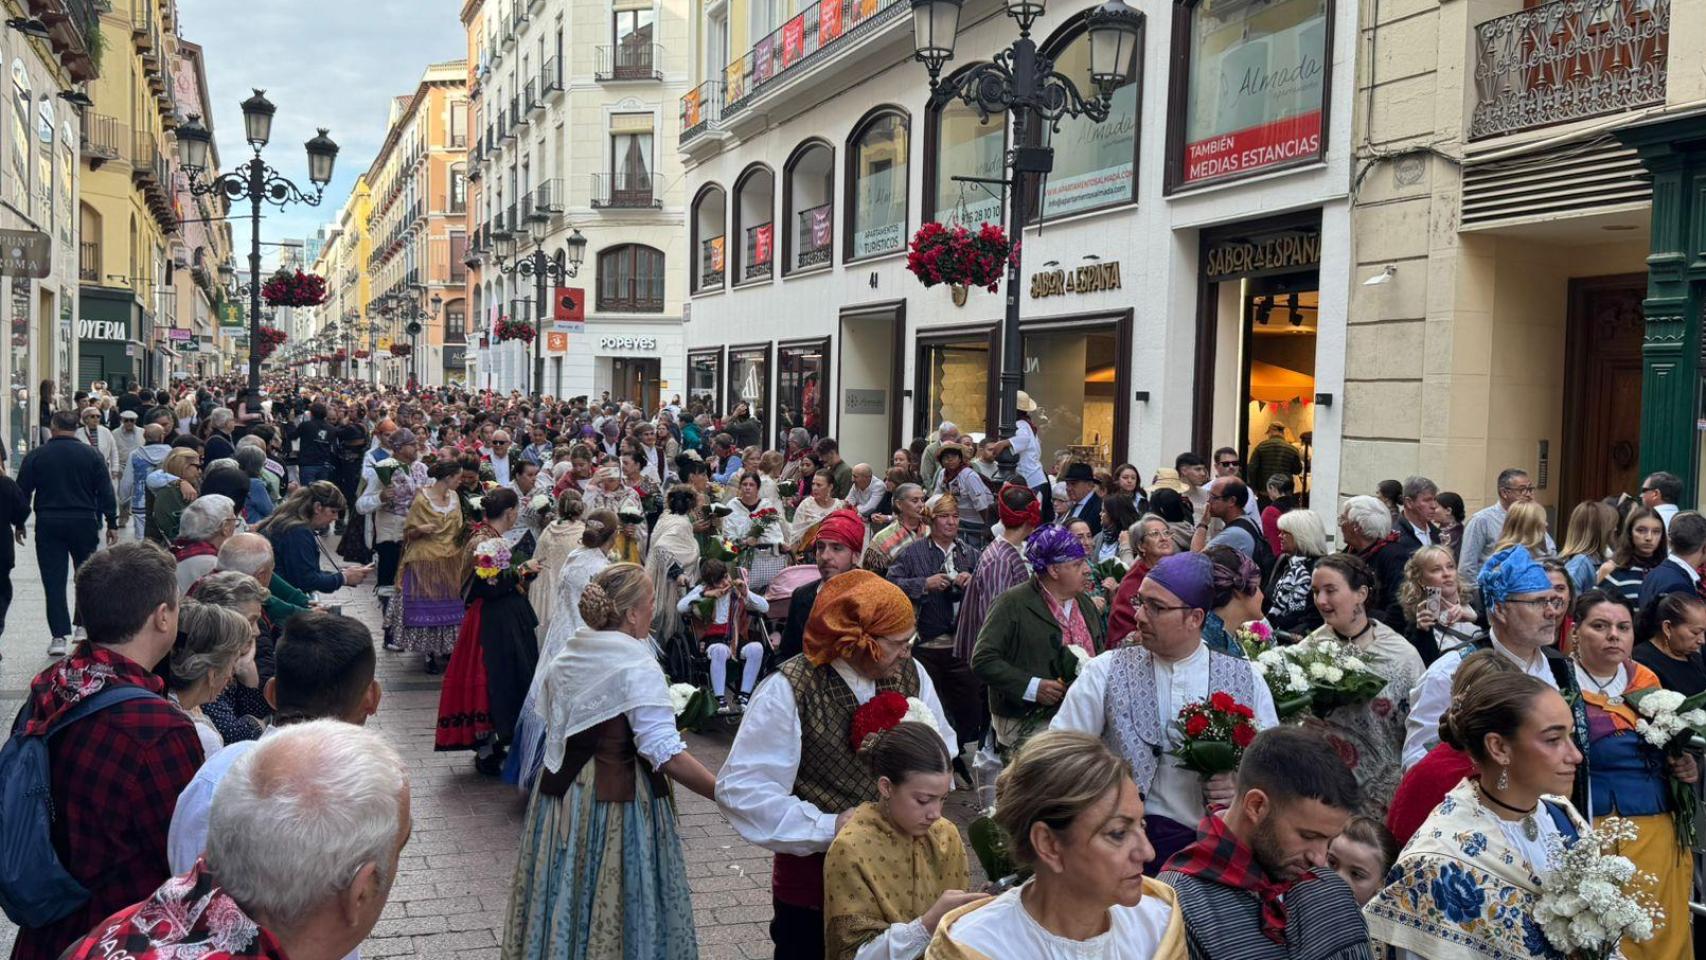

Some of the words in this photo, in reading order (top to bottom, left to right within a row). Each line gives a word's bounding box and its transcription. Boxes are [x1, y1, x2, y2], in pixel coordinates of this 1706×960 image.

[1239, 53, 1322, 96] Almada
[1190, 136, 1235, 159] TAMBIÉN
[1190, 154, 1238, 179] MEDIAS
[1241, 134, 1318, 168] ESTANCIAS
[993, 205, 1000, 218] 10
[0, 257, 38, 271] OMA
[1207, 243, 1254, 276] SABOR
[869, 271, 878, 289] 41
[1030, 269, 1065, 299] SABOR
[1075, 261, 1121, 294] ESPAÑA
